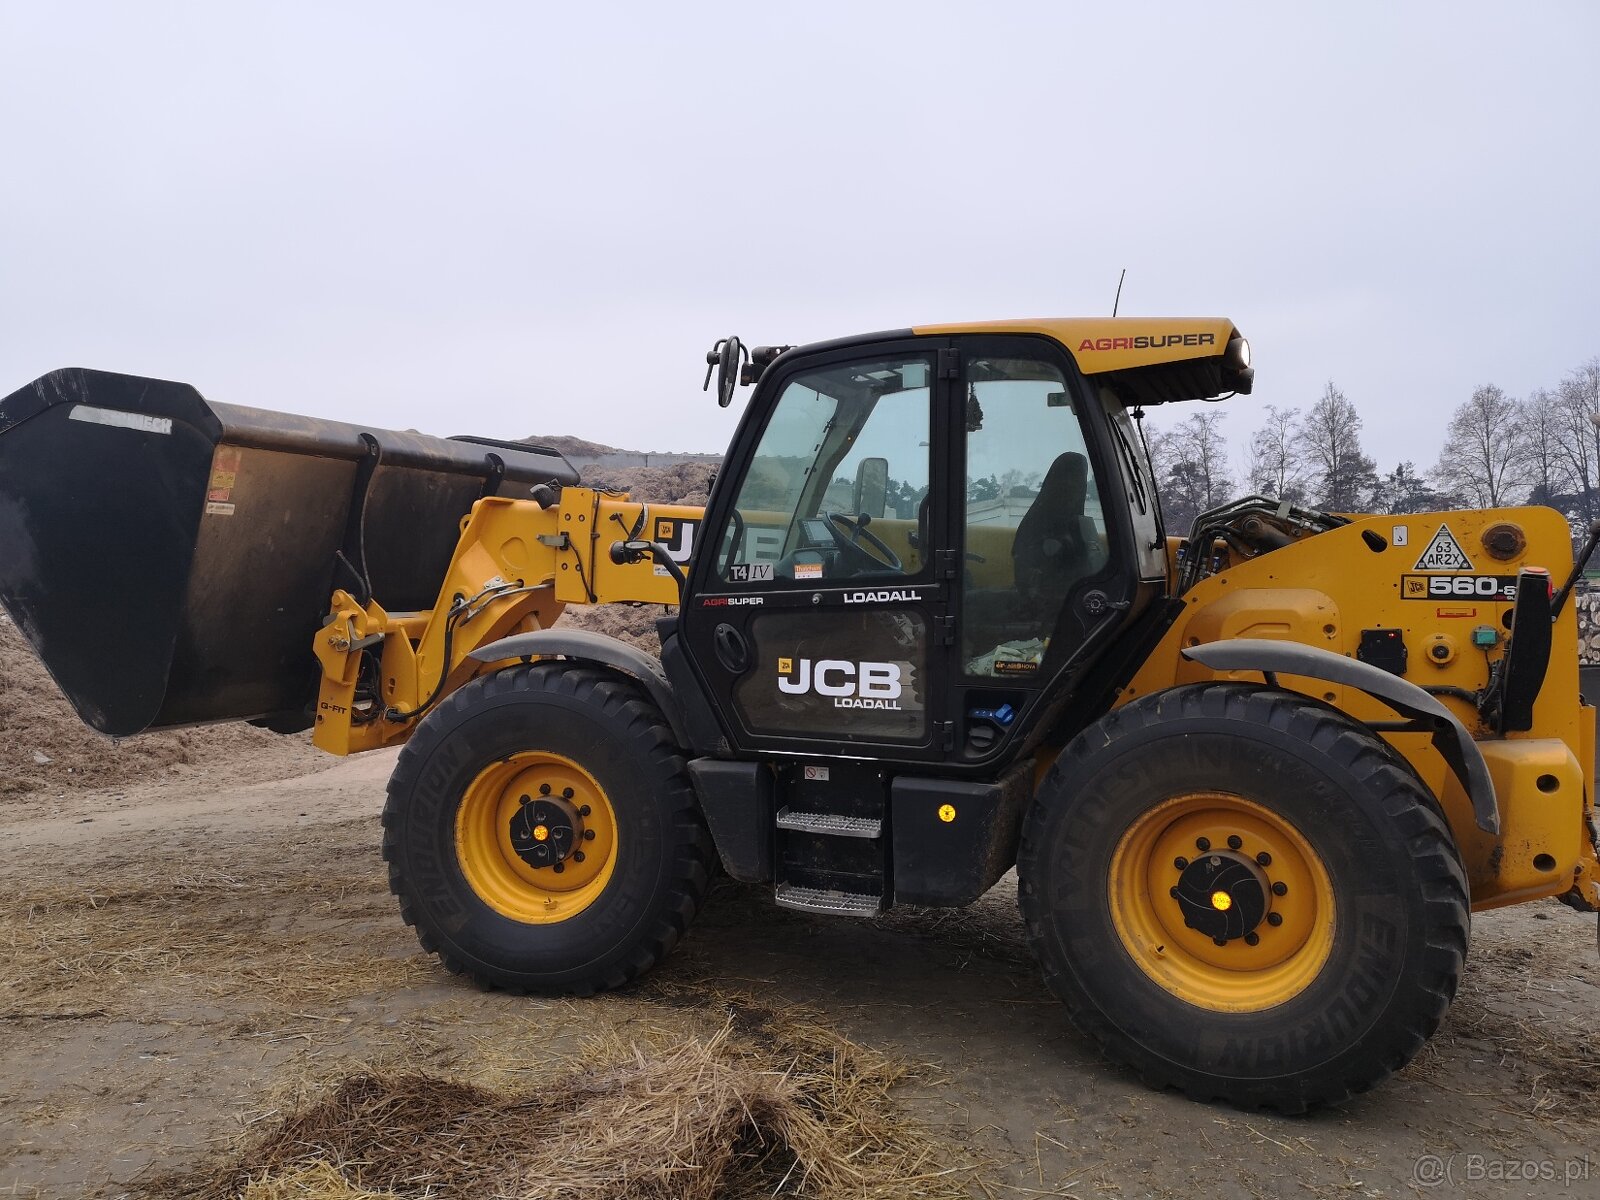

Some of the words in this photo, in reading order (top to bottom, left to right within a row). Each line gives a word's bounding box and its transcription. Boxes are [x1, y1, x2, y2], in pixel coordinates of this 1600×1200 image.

[1078, 333, 1215, 352] AGRISUPER
[1435, 541, 1452, 553] 63
[1427, 553, 1461, 566] AR2X
[730, 565, 748, 579] T4
[751, 564, 771, 578] IV
[703, 597, 764, 607] AGRISUPER
[843, 590, 922, 604] LOADALL
[778, 658, 902, 699] JCB
[321, 701, 347, 715] Q-FIT
[834, 698, 902, 711] LOADALL
